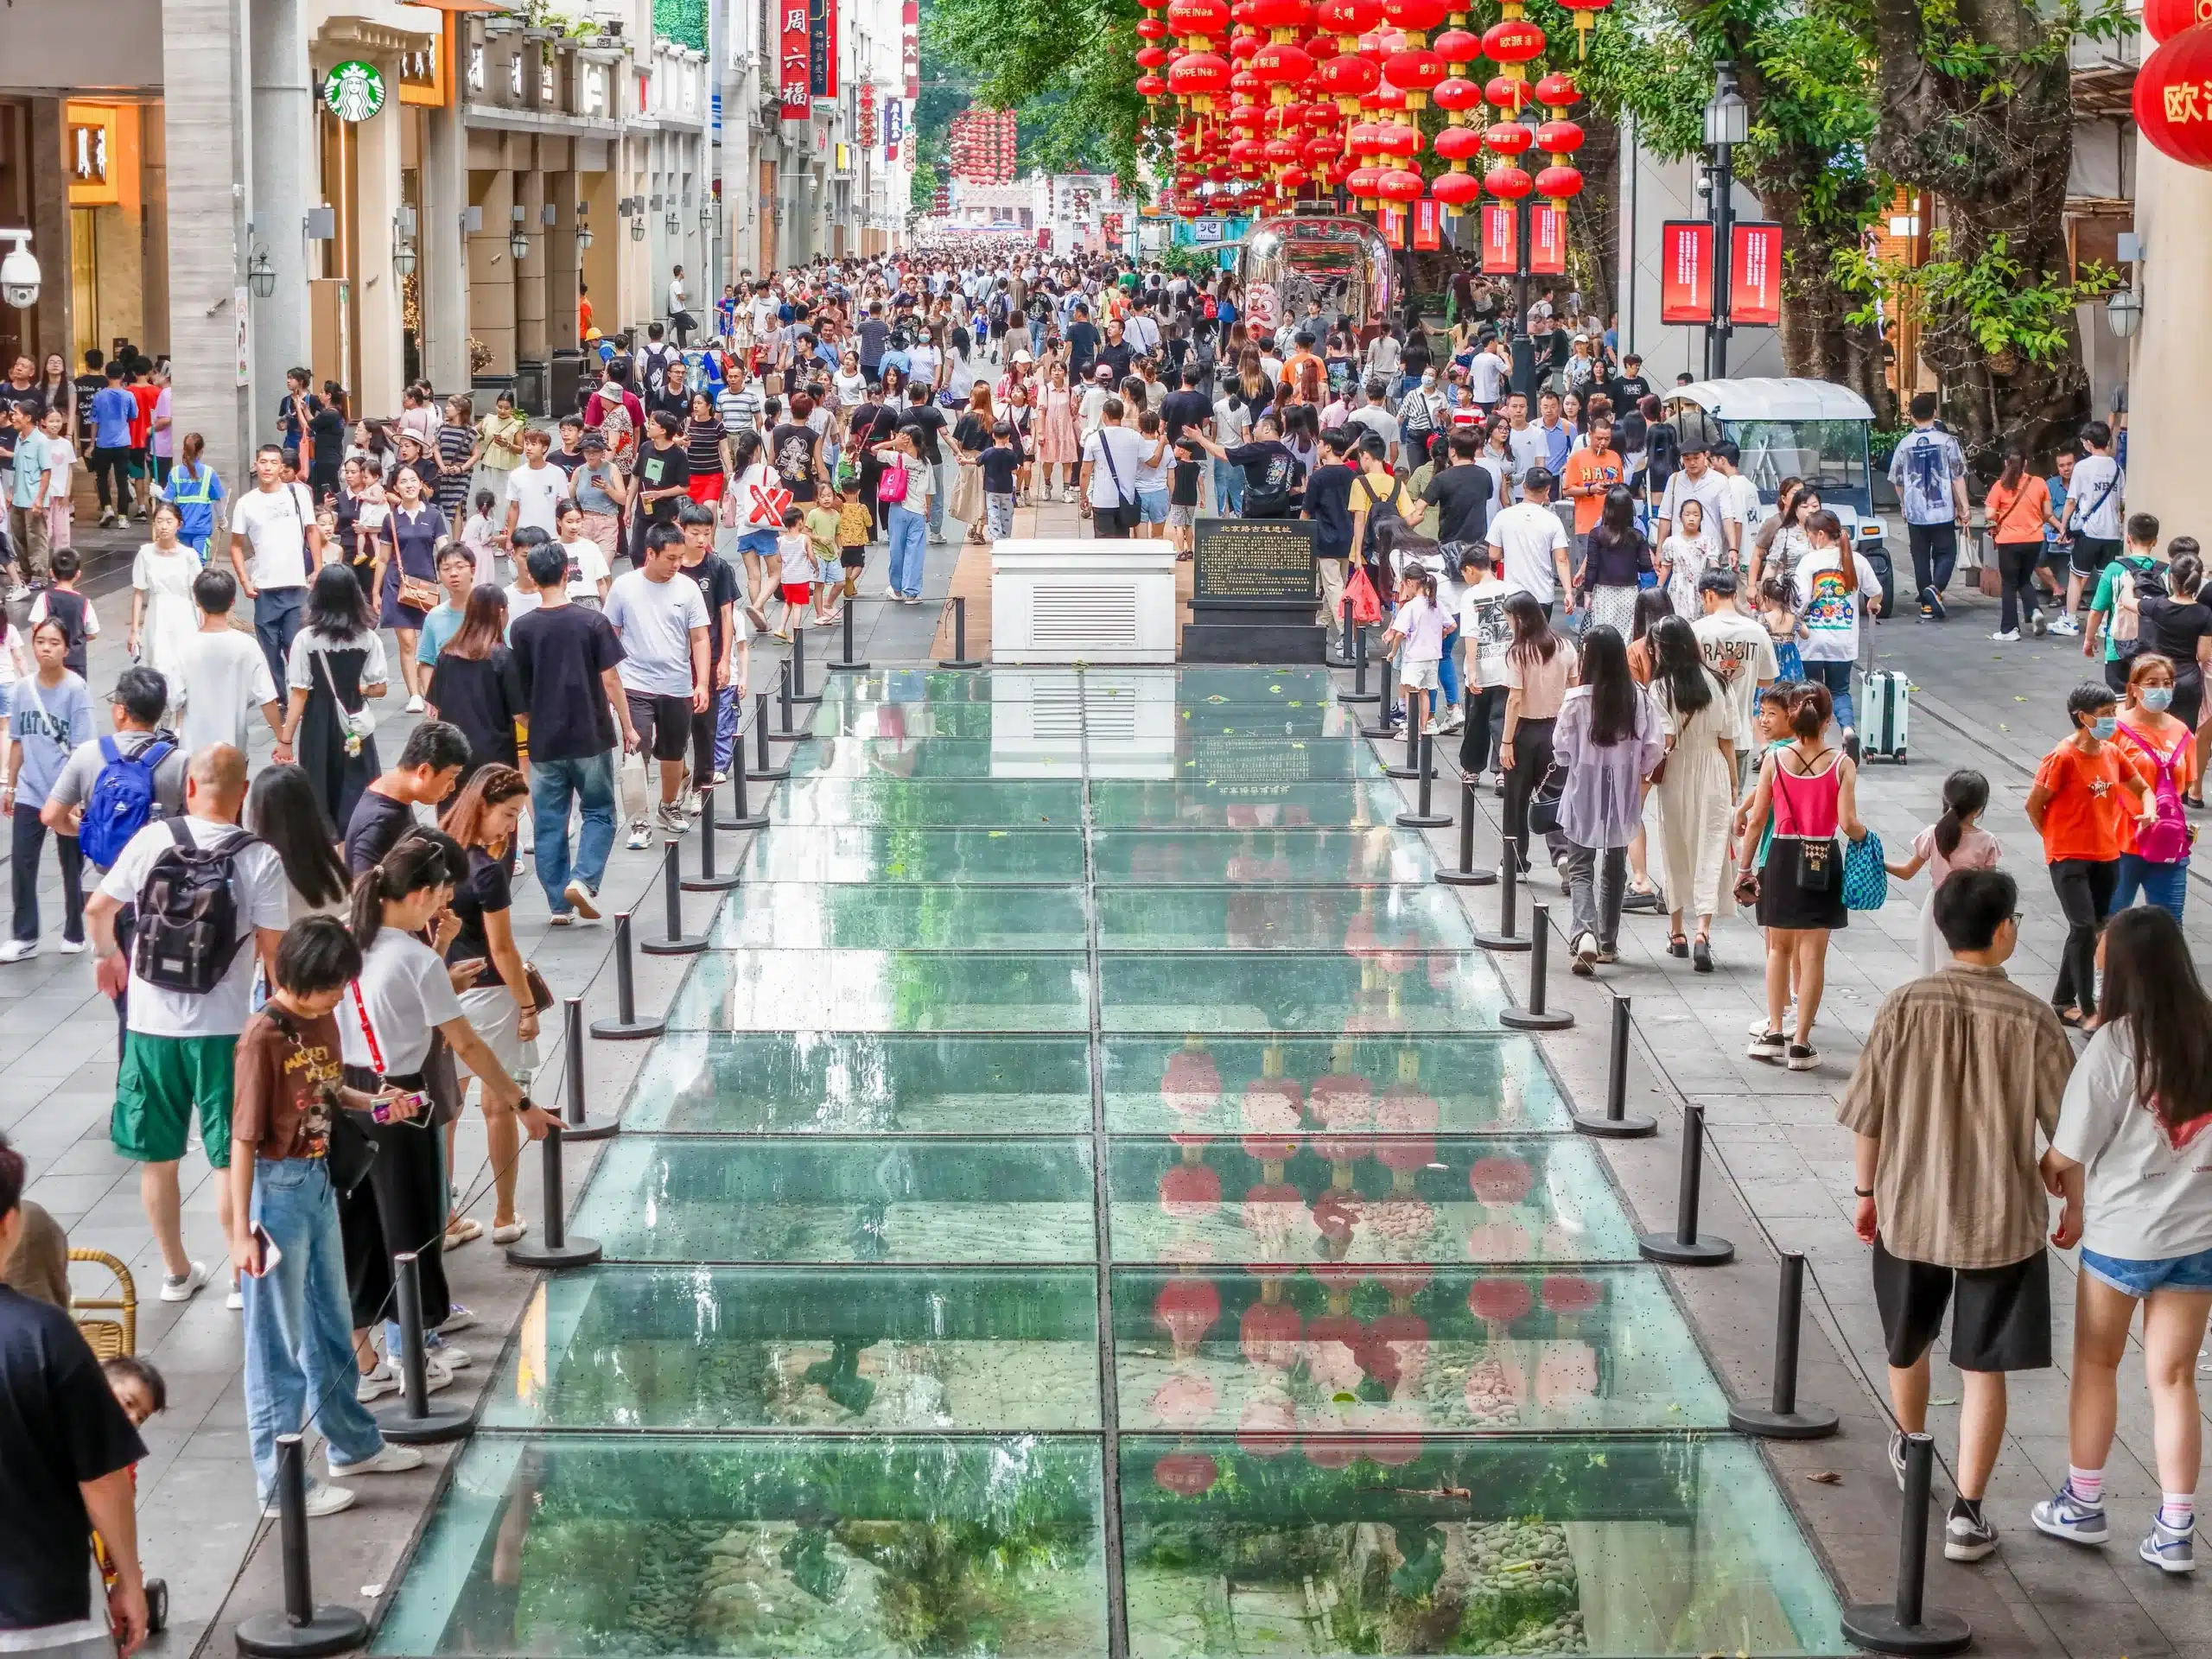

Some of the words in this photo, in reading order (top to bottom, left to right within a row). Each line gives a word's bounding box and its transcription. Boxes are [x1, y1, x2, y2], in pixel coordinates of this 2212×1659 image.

[1333, 7, 1354, 20] 文明
[783, 9, 807, 107] 周六福
[1703, 641, 1758, 661] RABBIT
